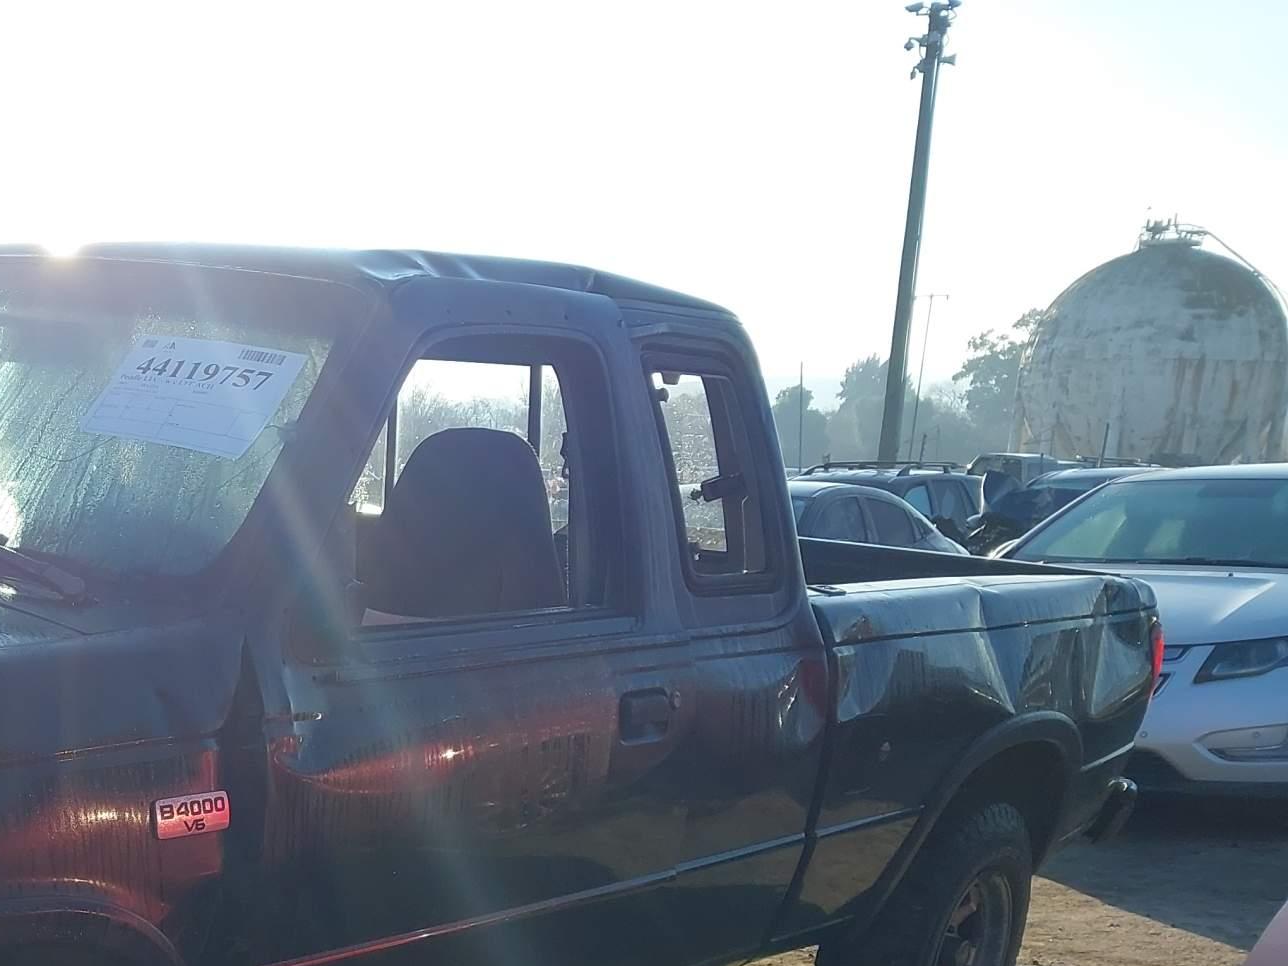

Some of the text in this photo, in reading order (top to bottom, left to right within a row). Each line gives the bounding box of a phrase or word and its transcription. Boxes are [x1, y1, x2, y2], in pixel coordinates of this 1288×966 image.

[136, 356, 274, 391] 44119757
[159, 796, 225, 820] B4000
[184, 818, 206, 832] V6
